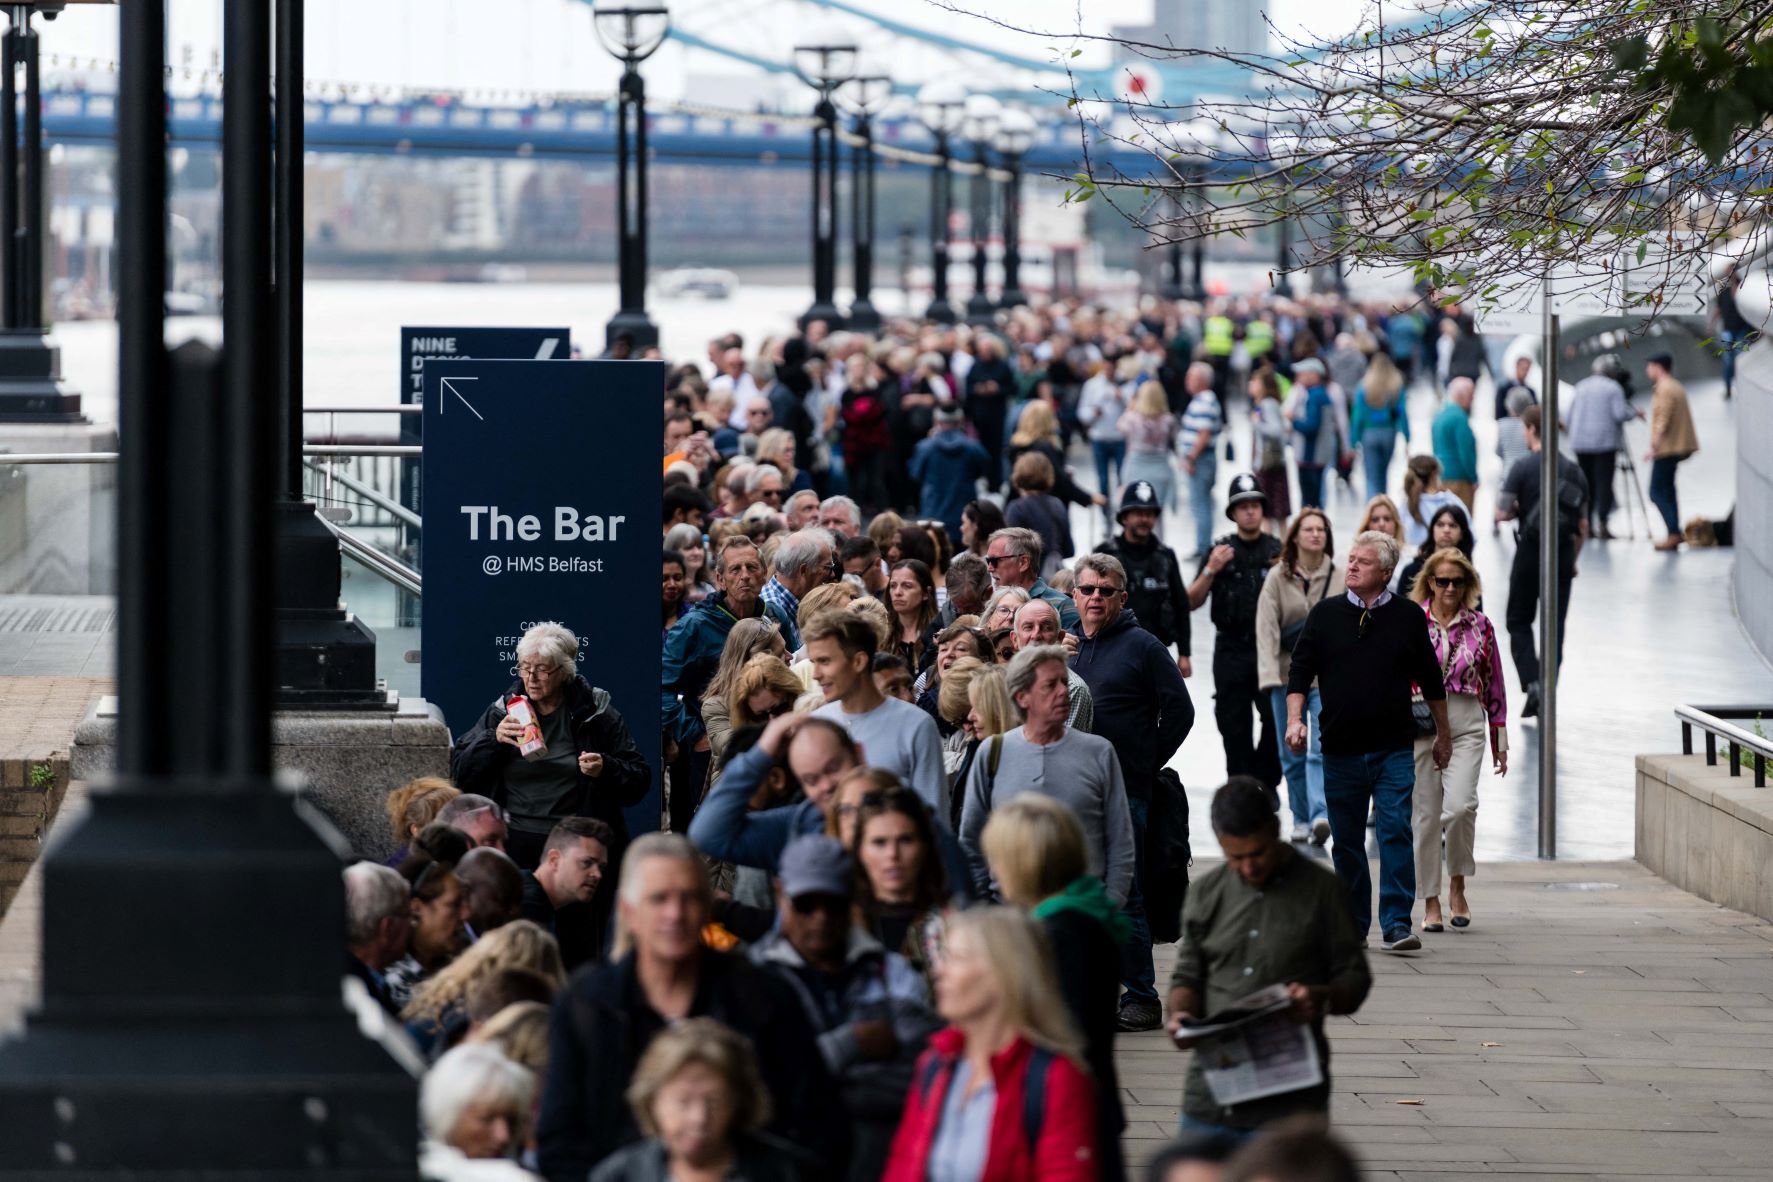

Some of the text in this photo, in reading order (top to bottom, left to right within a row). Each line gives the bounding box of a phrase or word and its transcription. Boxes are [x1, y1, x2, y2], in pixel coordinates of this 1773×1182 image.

[411, 337, 457, 353] NINE
[460, 506, 626, 541] The Bar
[482, 555, 603, 575] @ HMS Belfast
